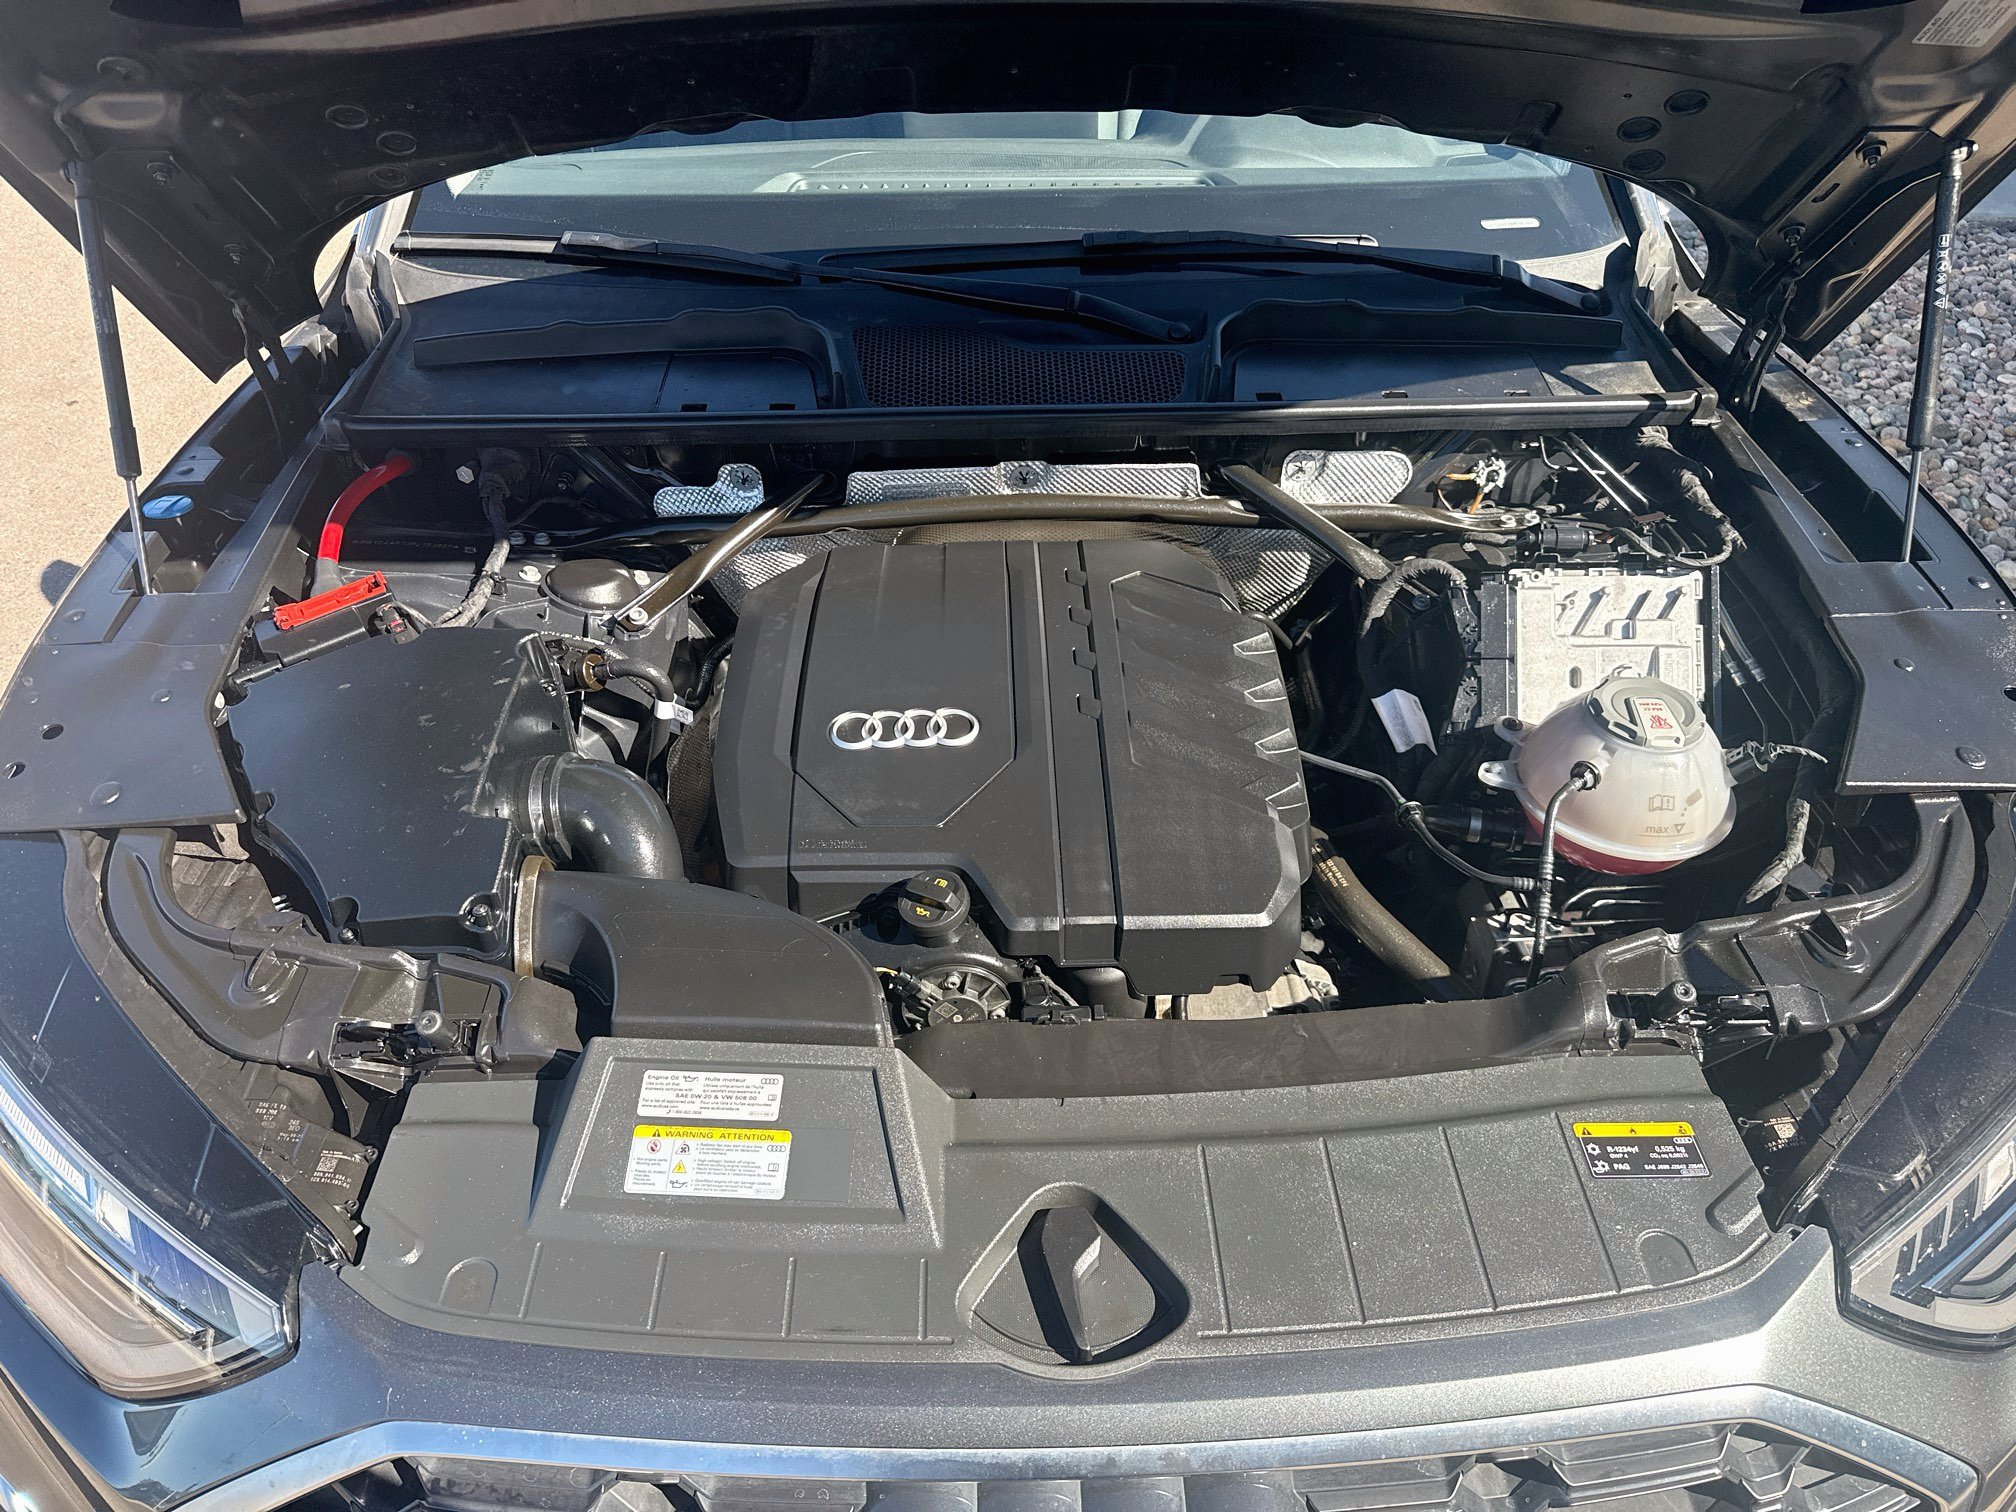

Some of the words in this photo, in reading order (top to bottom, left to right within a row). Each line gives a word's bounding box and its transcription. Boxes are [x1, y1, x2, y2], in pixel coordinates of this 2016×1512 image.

[1645, 824, 1670, 834] max
[665, 1130, 714, 1139] WARNING
[718, 1132, 775, 1141] ATTENTION
[1606, 1146, 1639, 1154] R-1234yf
